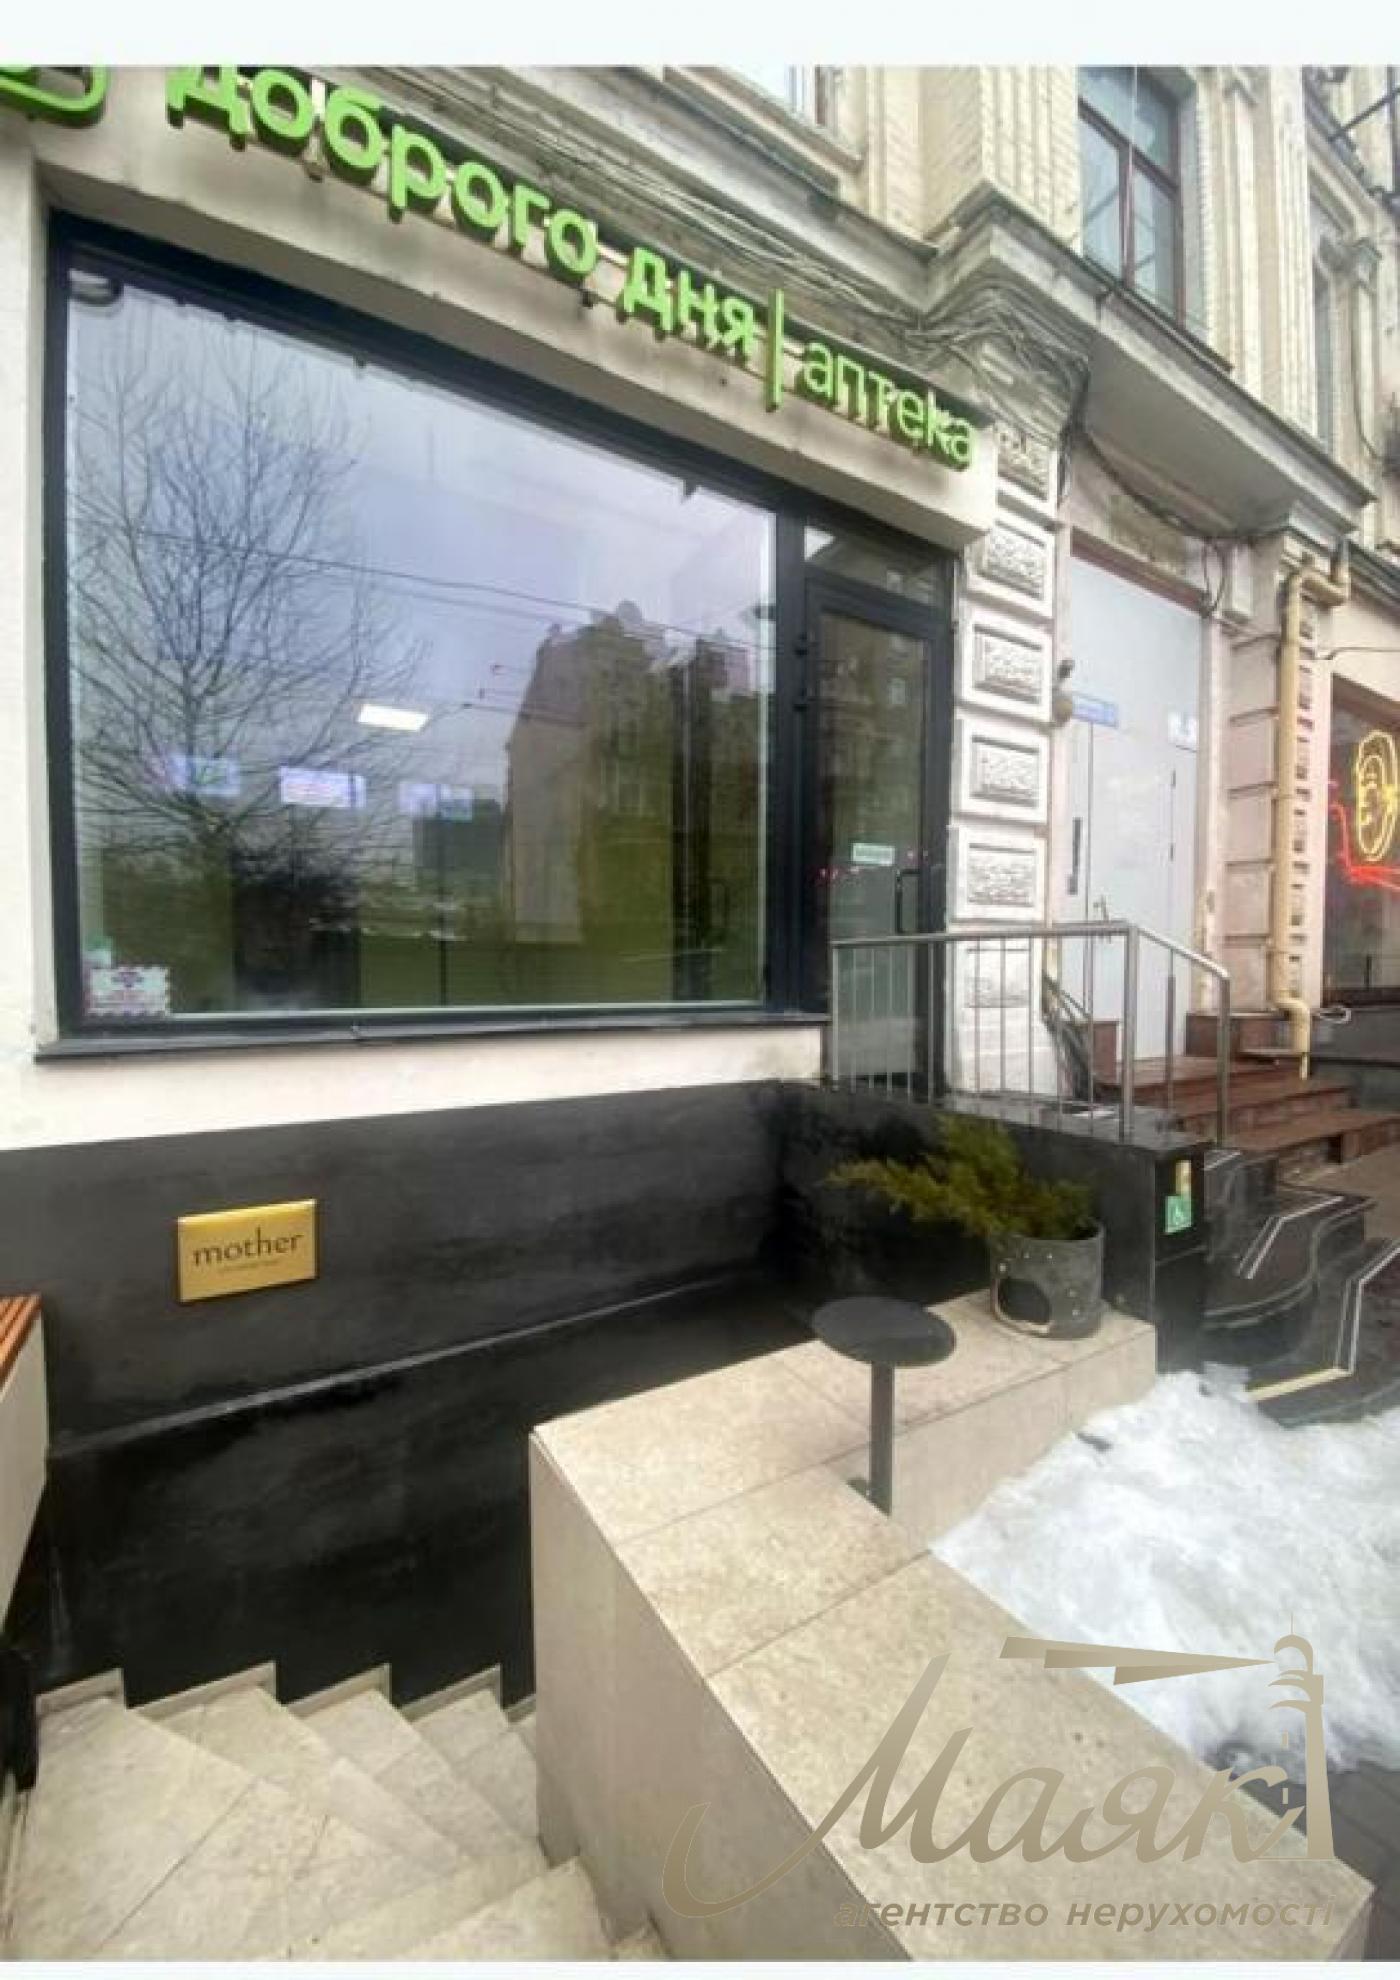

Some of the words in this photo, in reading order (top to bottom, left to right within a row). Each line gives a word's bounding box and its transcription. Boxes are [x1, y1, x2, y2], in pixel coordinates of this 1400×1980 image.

[622, 247, 755, 360] дня
[800, 341, 976, 469] аптека
[192, 1225, 304, 1266] mother
